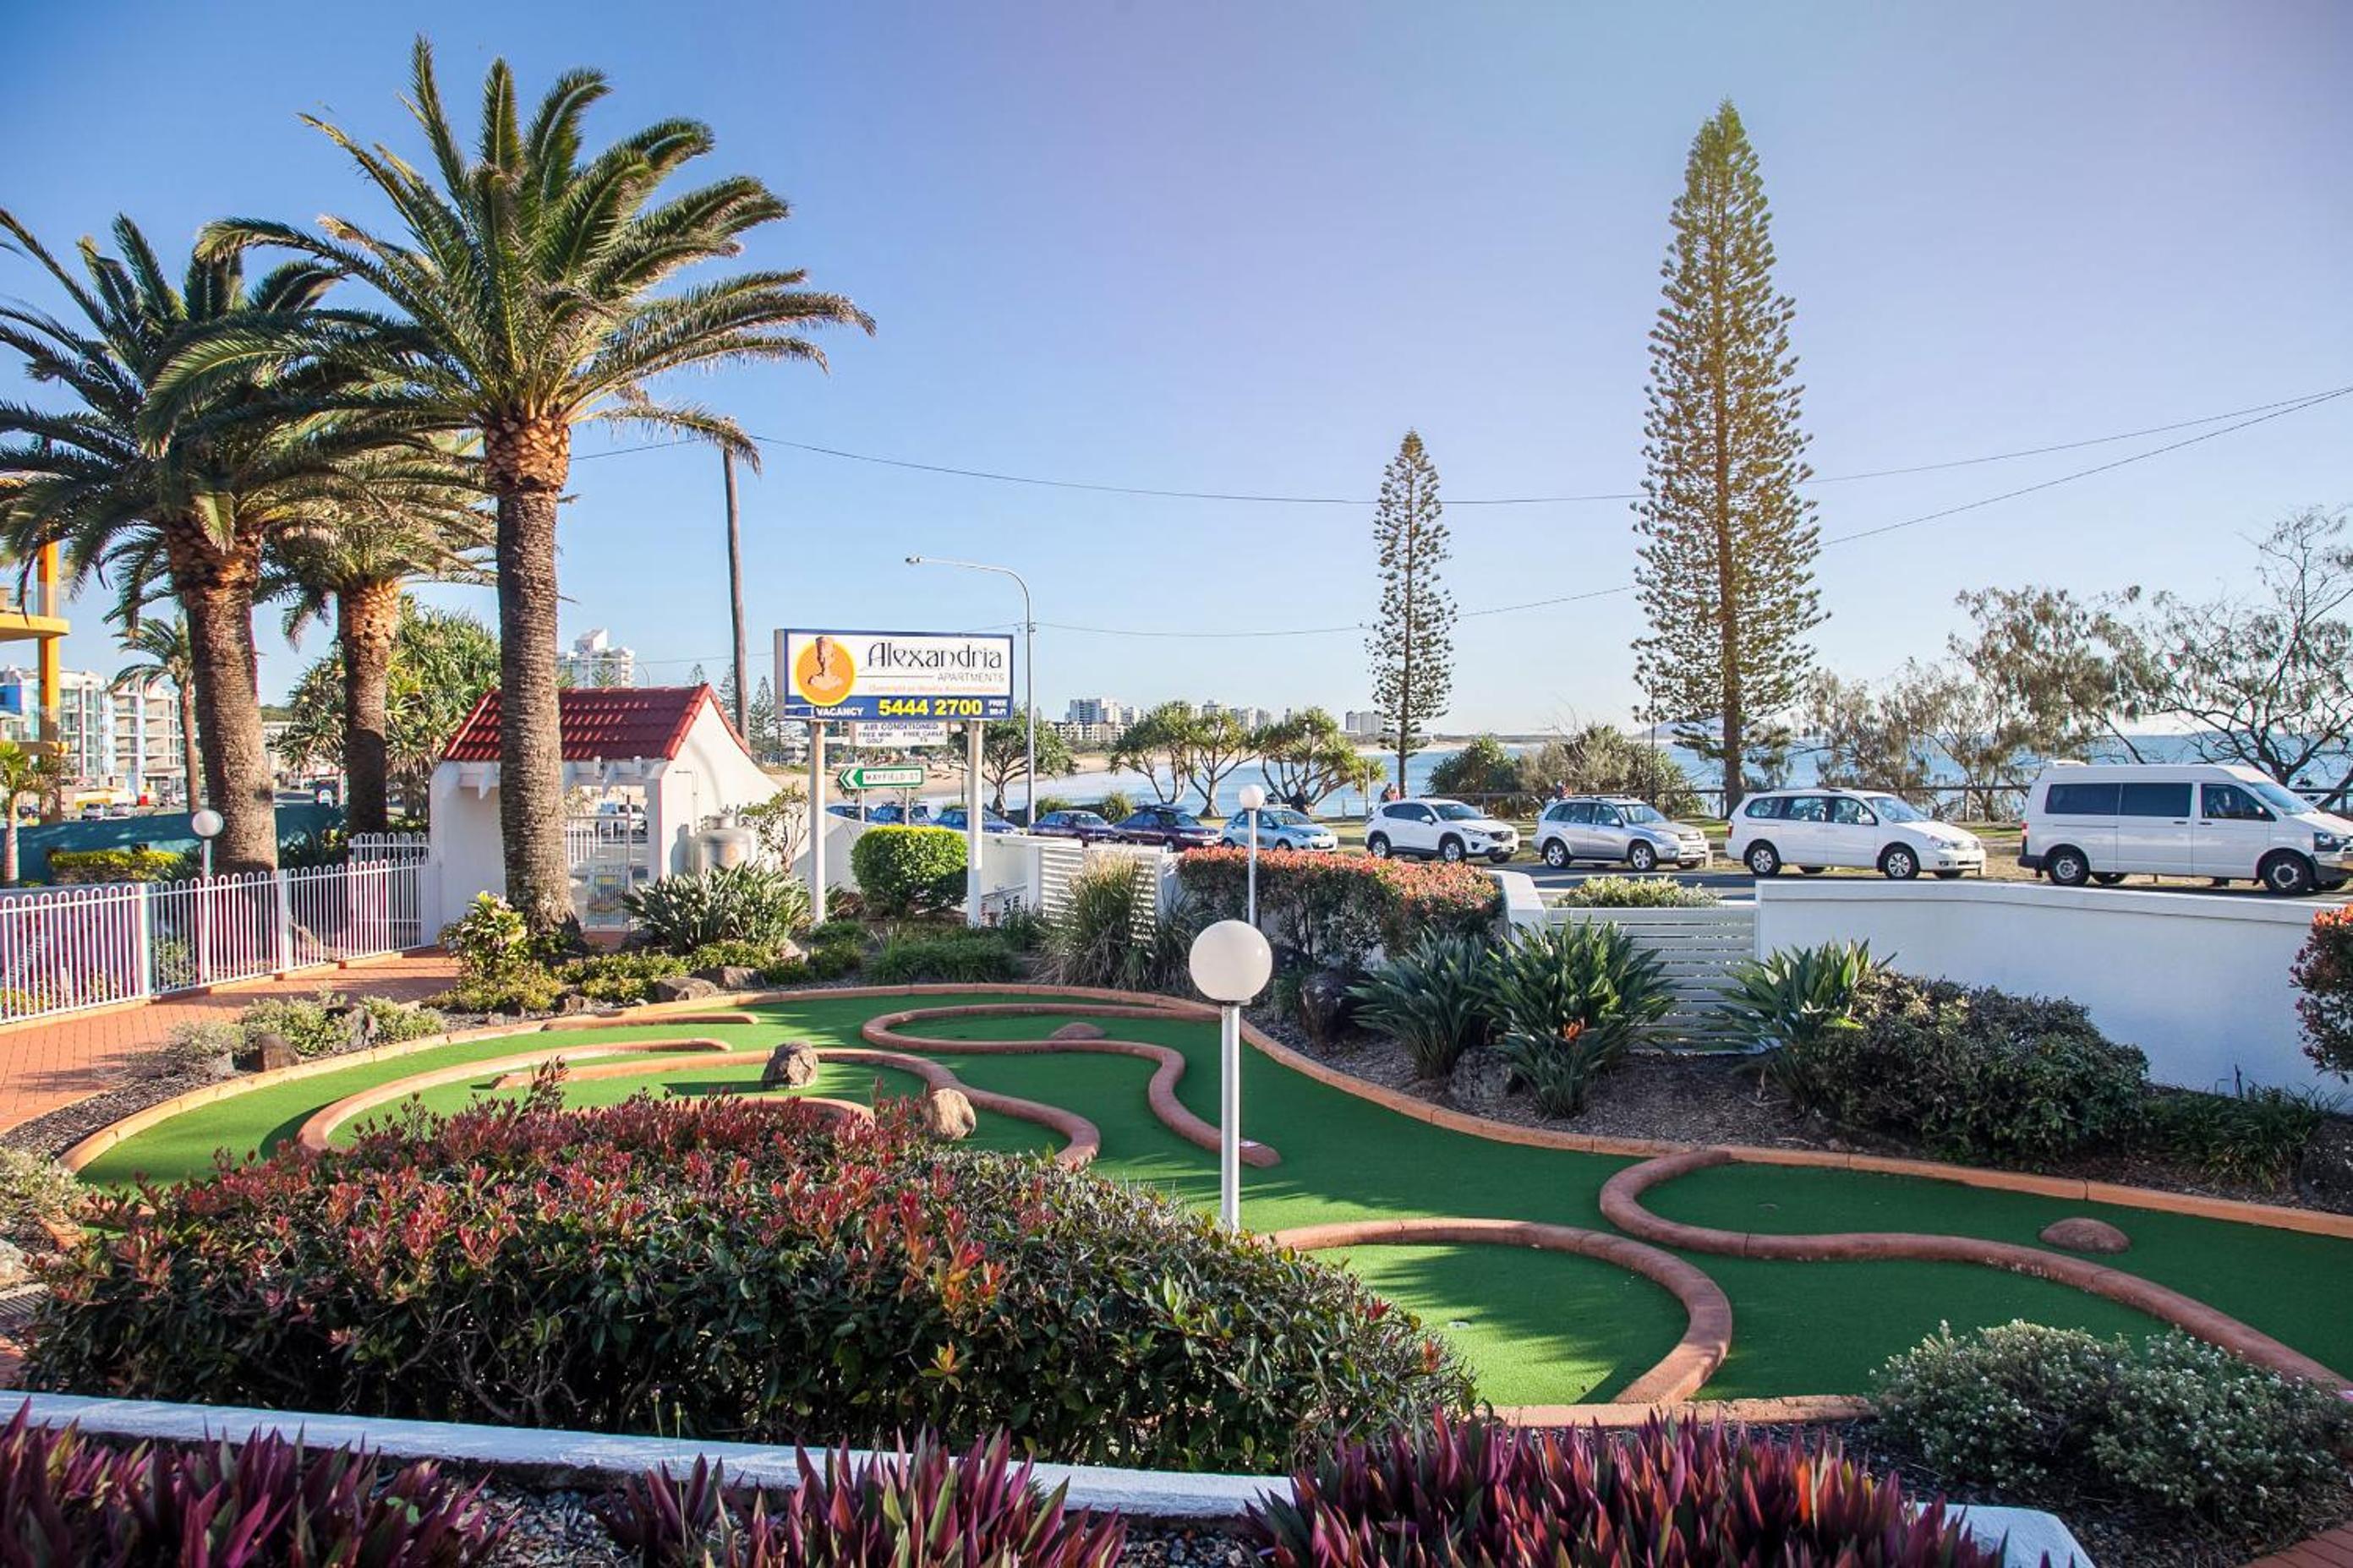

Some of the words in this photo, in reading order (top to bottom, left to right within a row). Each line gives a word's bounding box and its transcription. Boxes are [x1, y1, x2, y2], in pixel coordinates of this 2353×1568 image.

[868, 642, 1002, 669] Alexandria
[938, 672, 1004, 682] APARTMENTS
[816, 707, 864, 716] VACANCY
[878, 699, 929, 716] 5444
[934, 699, 983, 716] 2700
[865, 773, 906, 781] MAYFIELD
